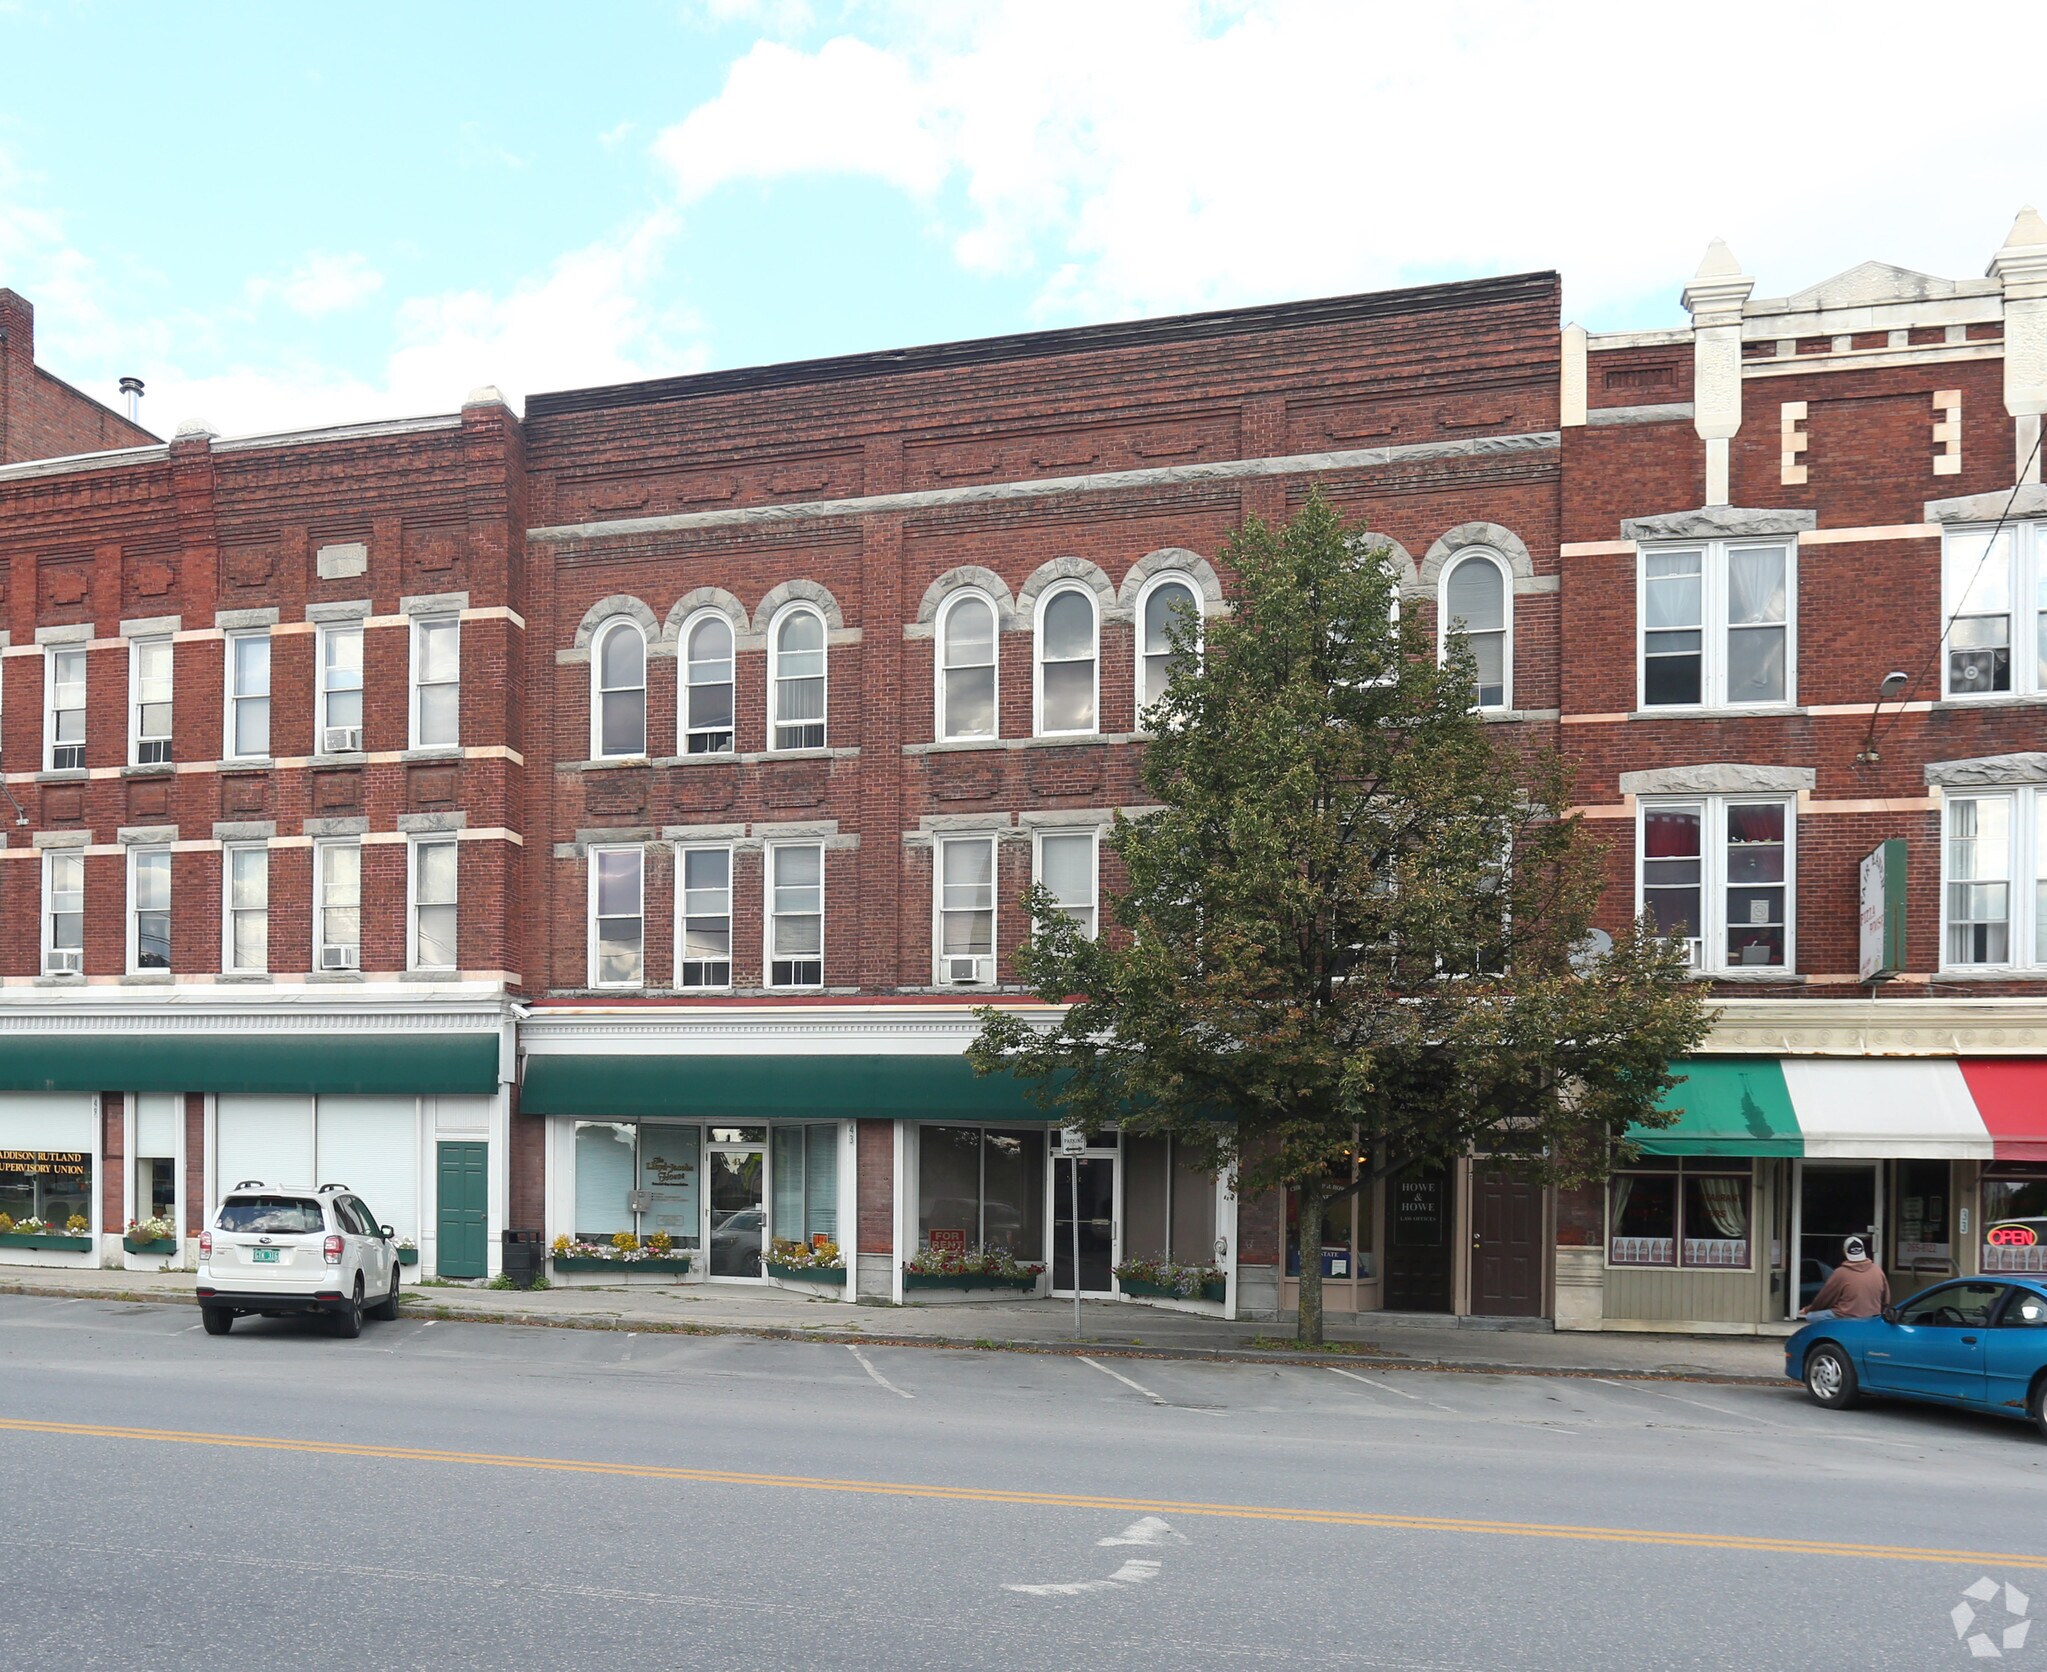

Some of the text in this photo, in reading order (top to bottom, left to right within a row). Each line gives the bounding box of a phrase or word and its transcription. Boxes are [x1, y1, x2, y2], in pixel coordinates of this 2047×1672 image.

[38, 1152, 82, 1163] RUTLAND
[0, 1162, 84, 1175] UPERVISORY UNION
[1402, 1183, 1435, 1192] HOWE
[1414, 1193, 1423, 1202] &
[1401, 1202, 1435, 1212] HOWE
[935, 1231, 960, 1240] FOR
[1990, 1229, 2034, 1246] OPEN
[932, 1240, 963, 1250] RENT
